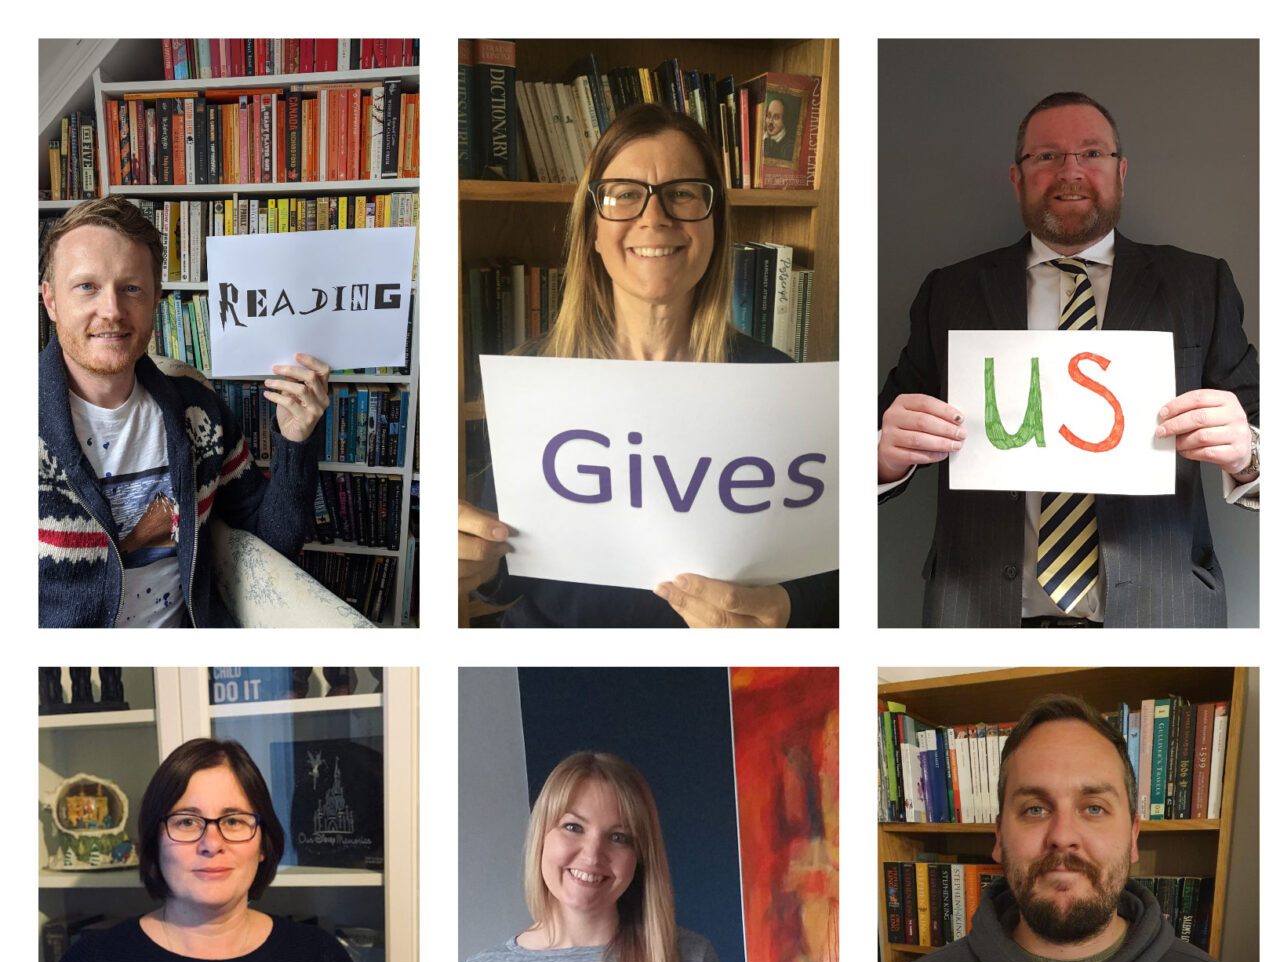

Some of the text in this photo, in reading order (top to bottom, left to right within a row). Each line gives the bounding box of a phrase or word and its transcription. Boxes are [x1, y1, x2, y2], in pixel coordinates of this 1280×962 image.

[288, 96, 299, 130] CANADA
[489, 68, 508, 161] DICTIONARY
[82, 127, 91, 141] THE
[806, 98, 820, 187] SHAKESPEARE
[82, 142, 93, 168] FIVE
[219, 282, 401, 331] READING
[542, 429, 827, 513] Gives
[213, 679, 262, 704] DO IT
[1155, 722, 1165, 796] GULLIVER'S TRAVELS
[1180, 759, 1190, 777] 1606
[1198, 746, 1207, 768] 1599
[953, 868, 963, 938] STEPHEN KING
